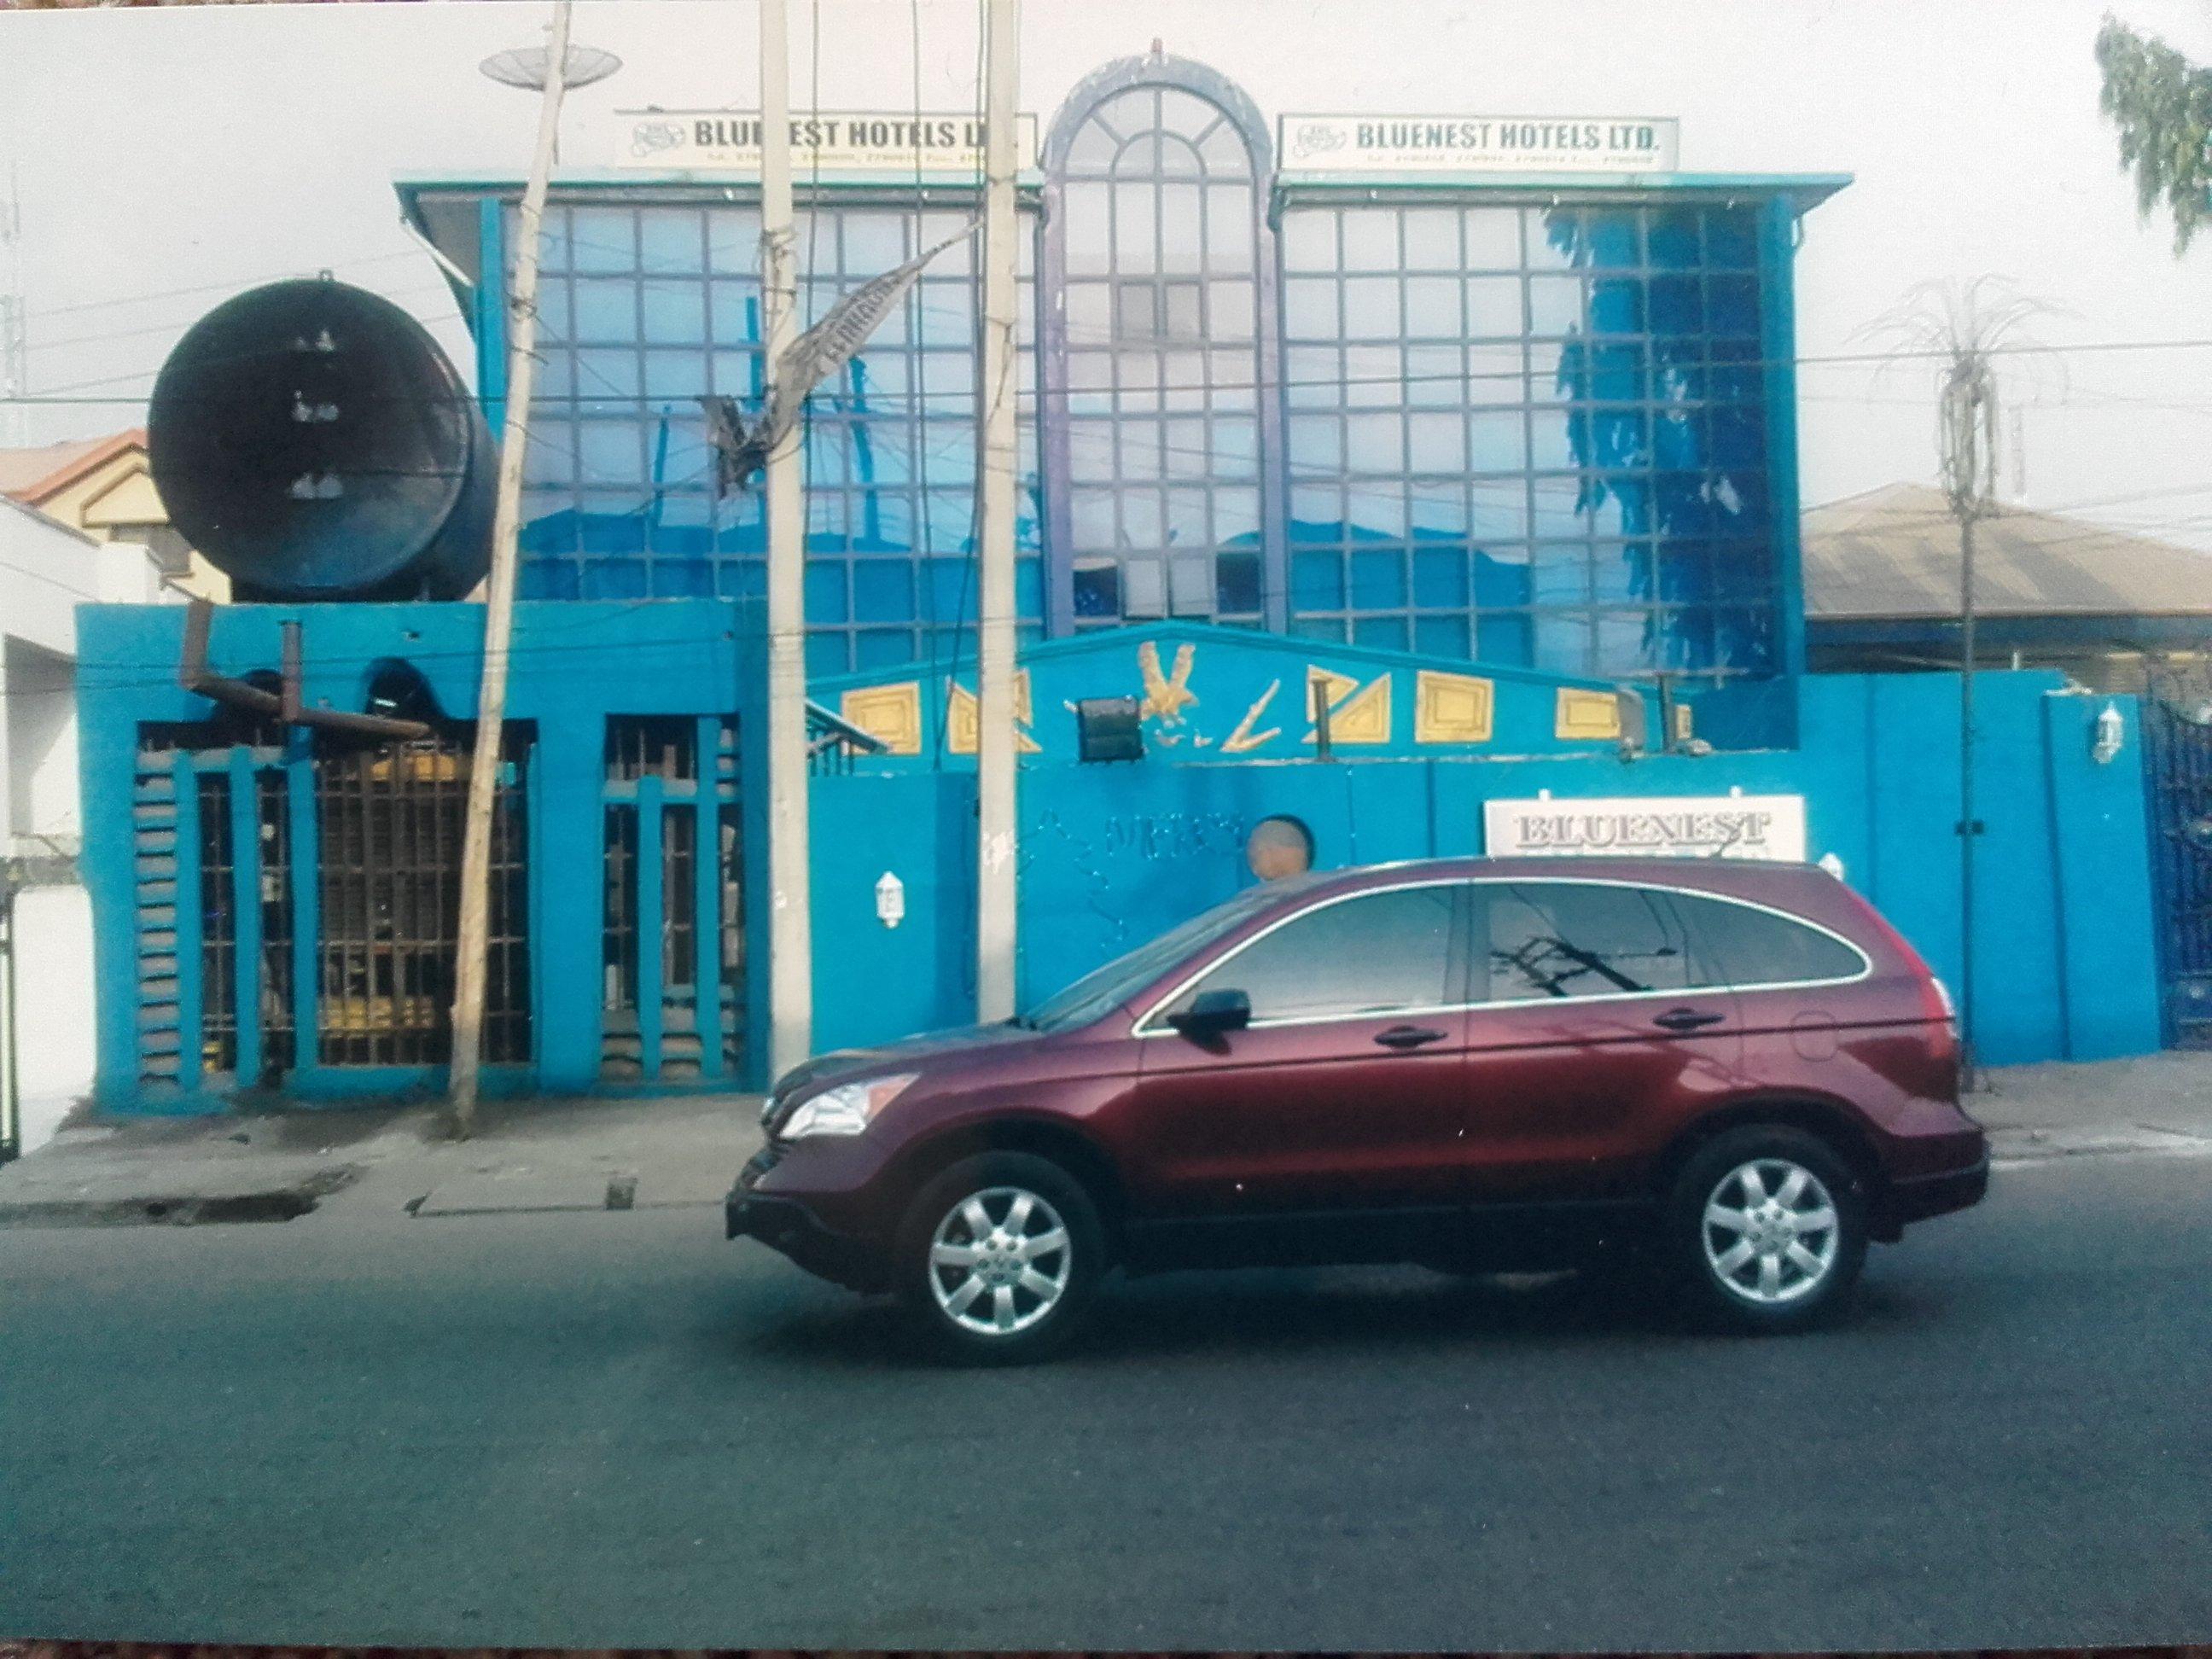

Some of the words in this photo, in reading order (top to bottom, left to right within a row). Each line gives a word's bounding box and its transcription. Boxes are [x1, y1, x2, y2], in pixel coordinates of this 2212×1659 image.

[695, 120, 840, 147] BLUEEST
[849, 121, 956, 148] HOTELS
[1357, 123, 1492, 149] BLUENEST
[1499, 124, 1601, 150] HOTELS
[1609, 125, 1660, 151] LTD.
[1514, 812, 1772, 847] BLUENEST
